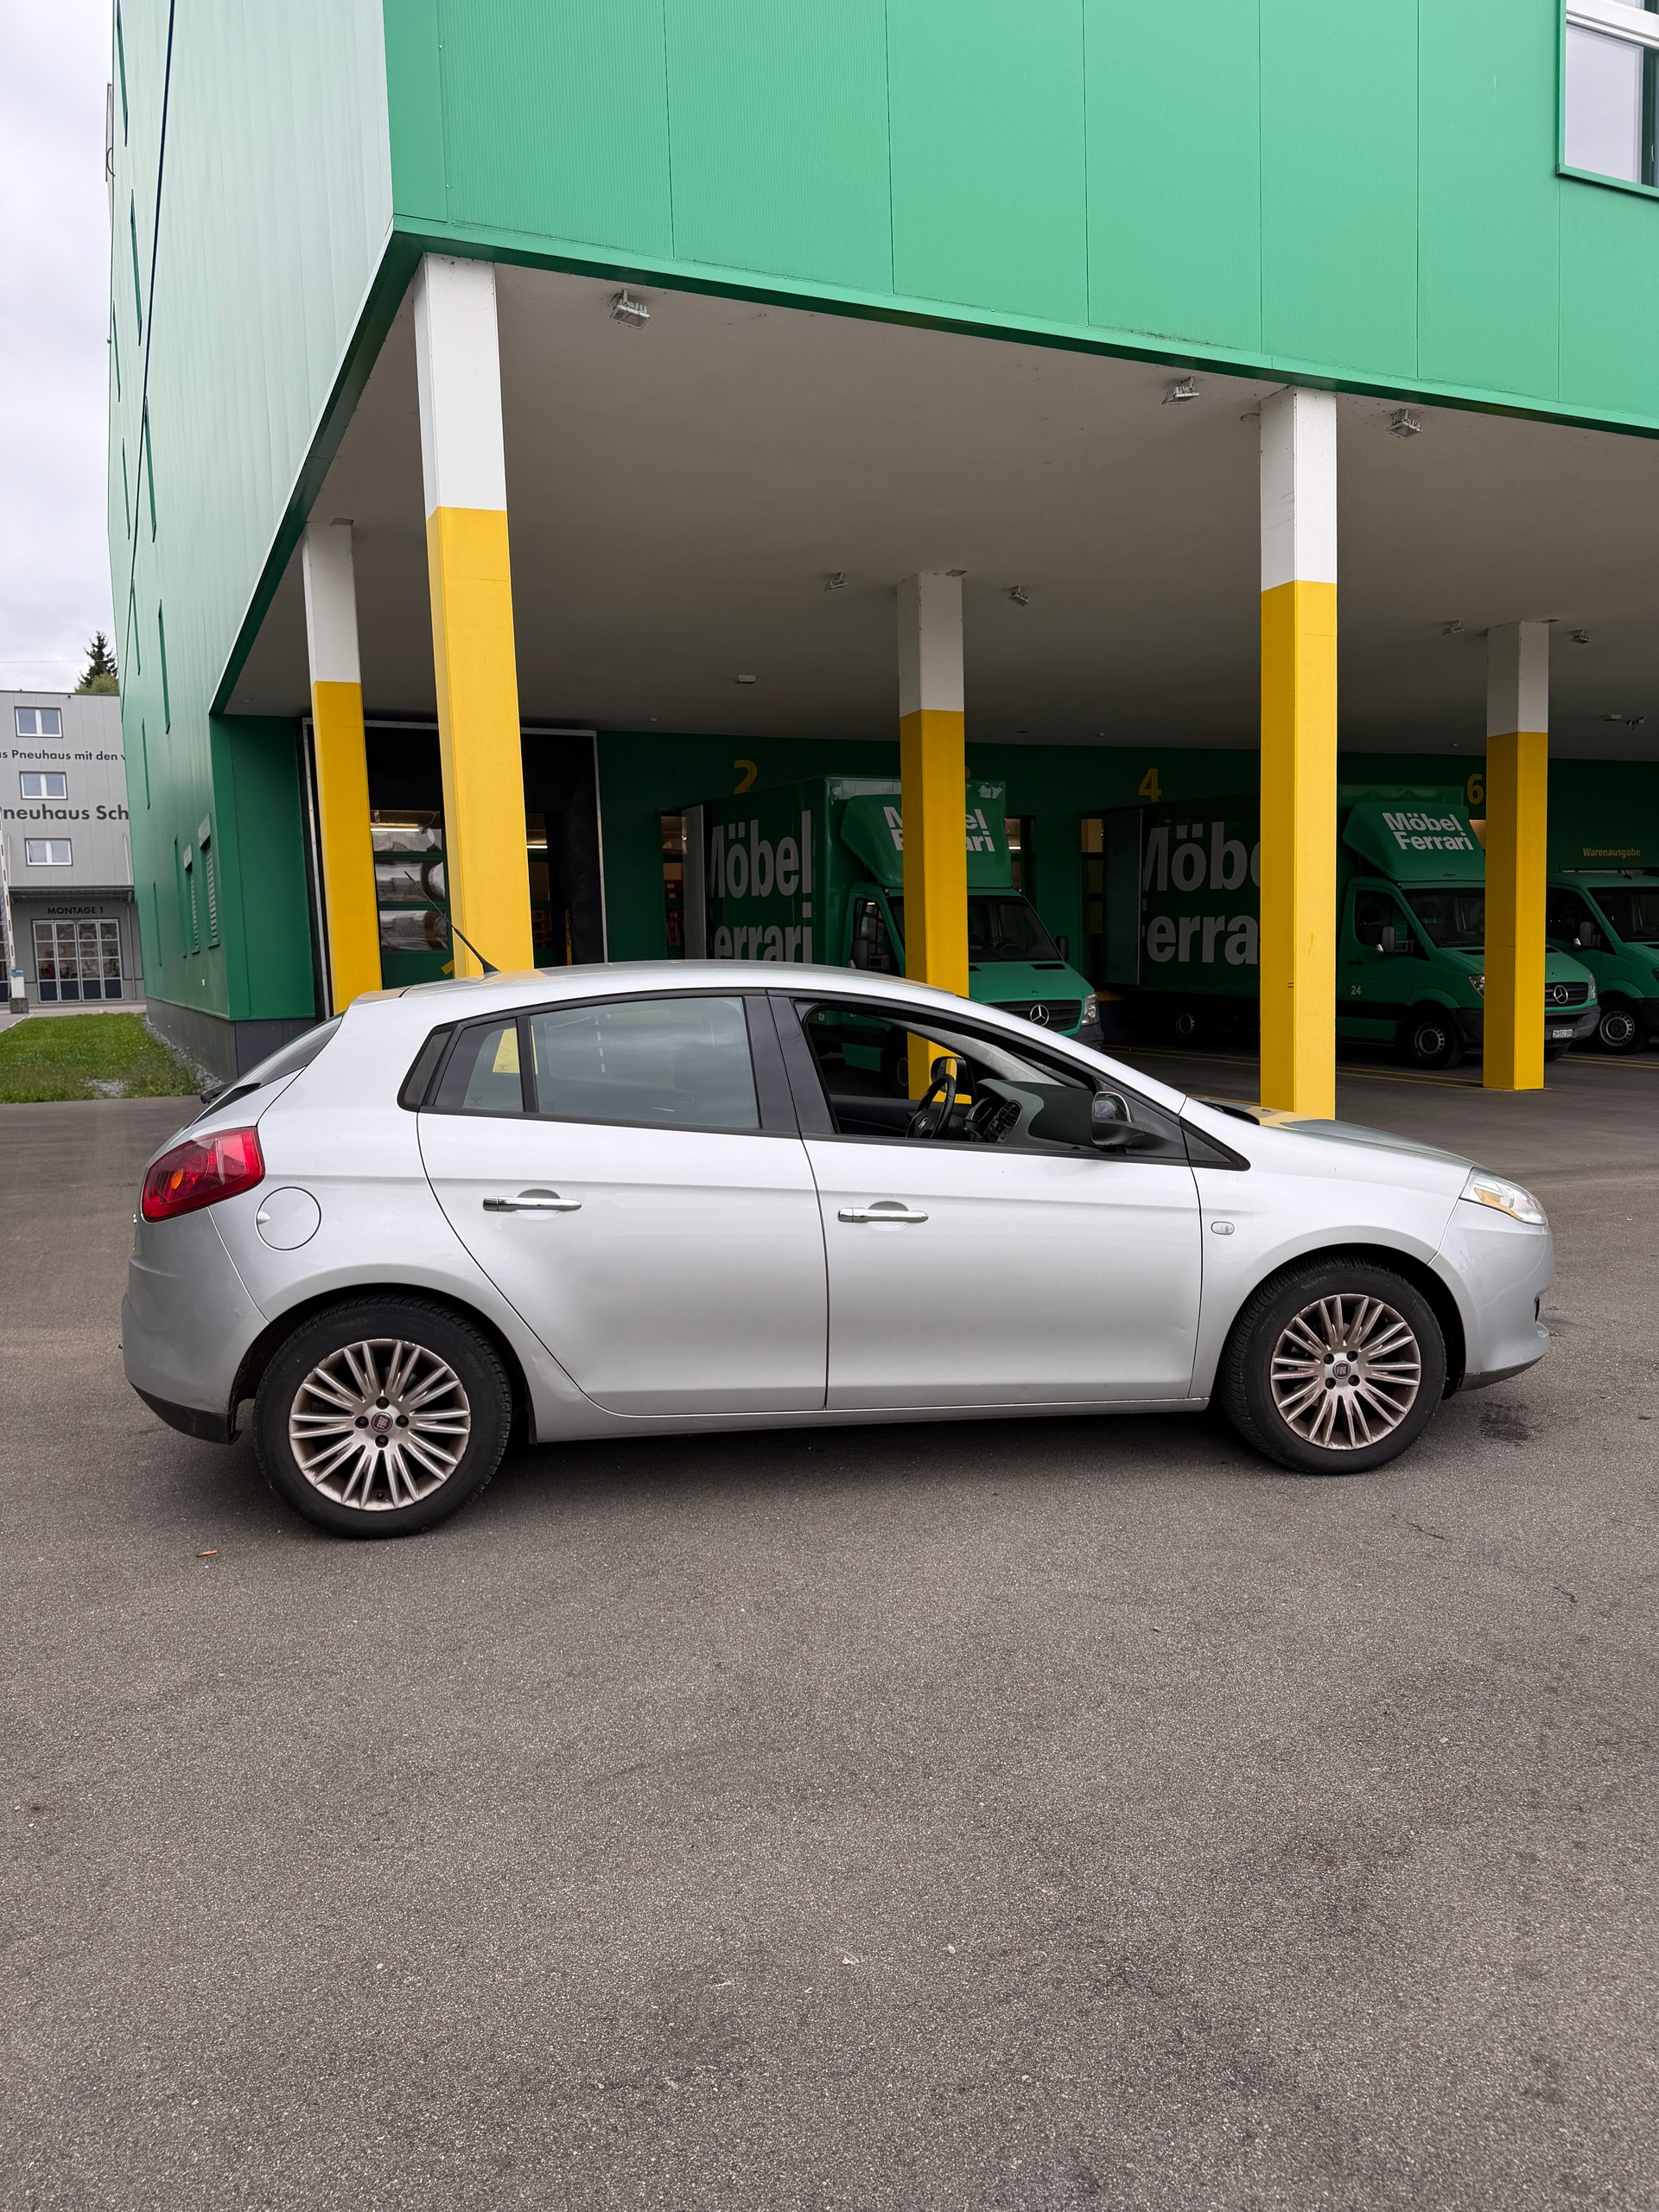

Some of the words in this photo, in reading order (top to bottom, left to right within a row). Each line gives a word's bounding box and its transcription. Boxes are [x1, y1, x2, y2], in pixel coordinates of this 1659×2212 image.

[12, 749, 71, 760] Pneuhaus
[75, 750, 92, 760] mit
[96, 751, 118, 761] den
[734, 760, 758, 794] 2
[1139, 768, 1161, 802] 4
[1467, 773, 1484, 804] 6
[0, 804, 90, 820] neuhaus
[96, 804, 129, 820] Sch
[1382, 812, 1464, 831] Möbel
[1393, 831, 1475, 850] Ferrari
[1583, 848, 1641, 858] Warenausgabe
[712, 902, 812, 963] errari
[1351, 985, 1362, 995] 24
[1337, 1366, 1347, 1375] FIAT
